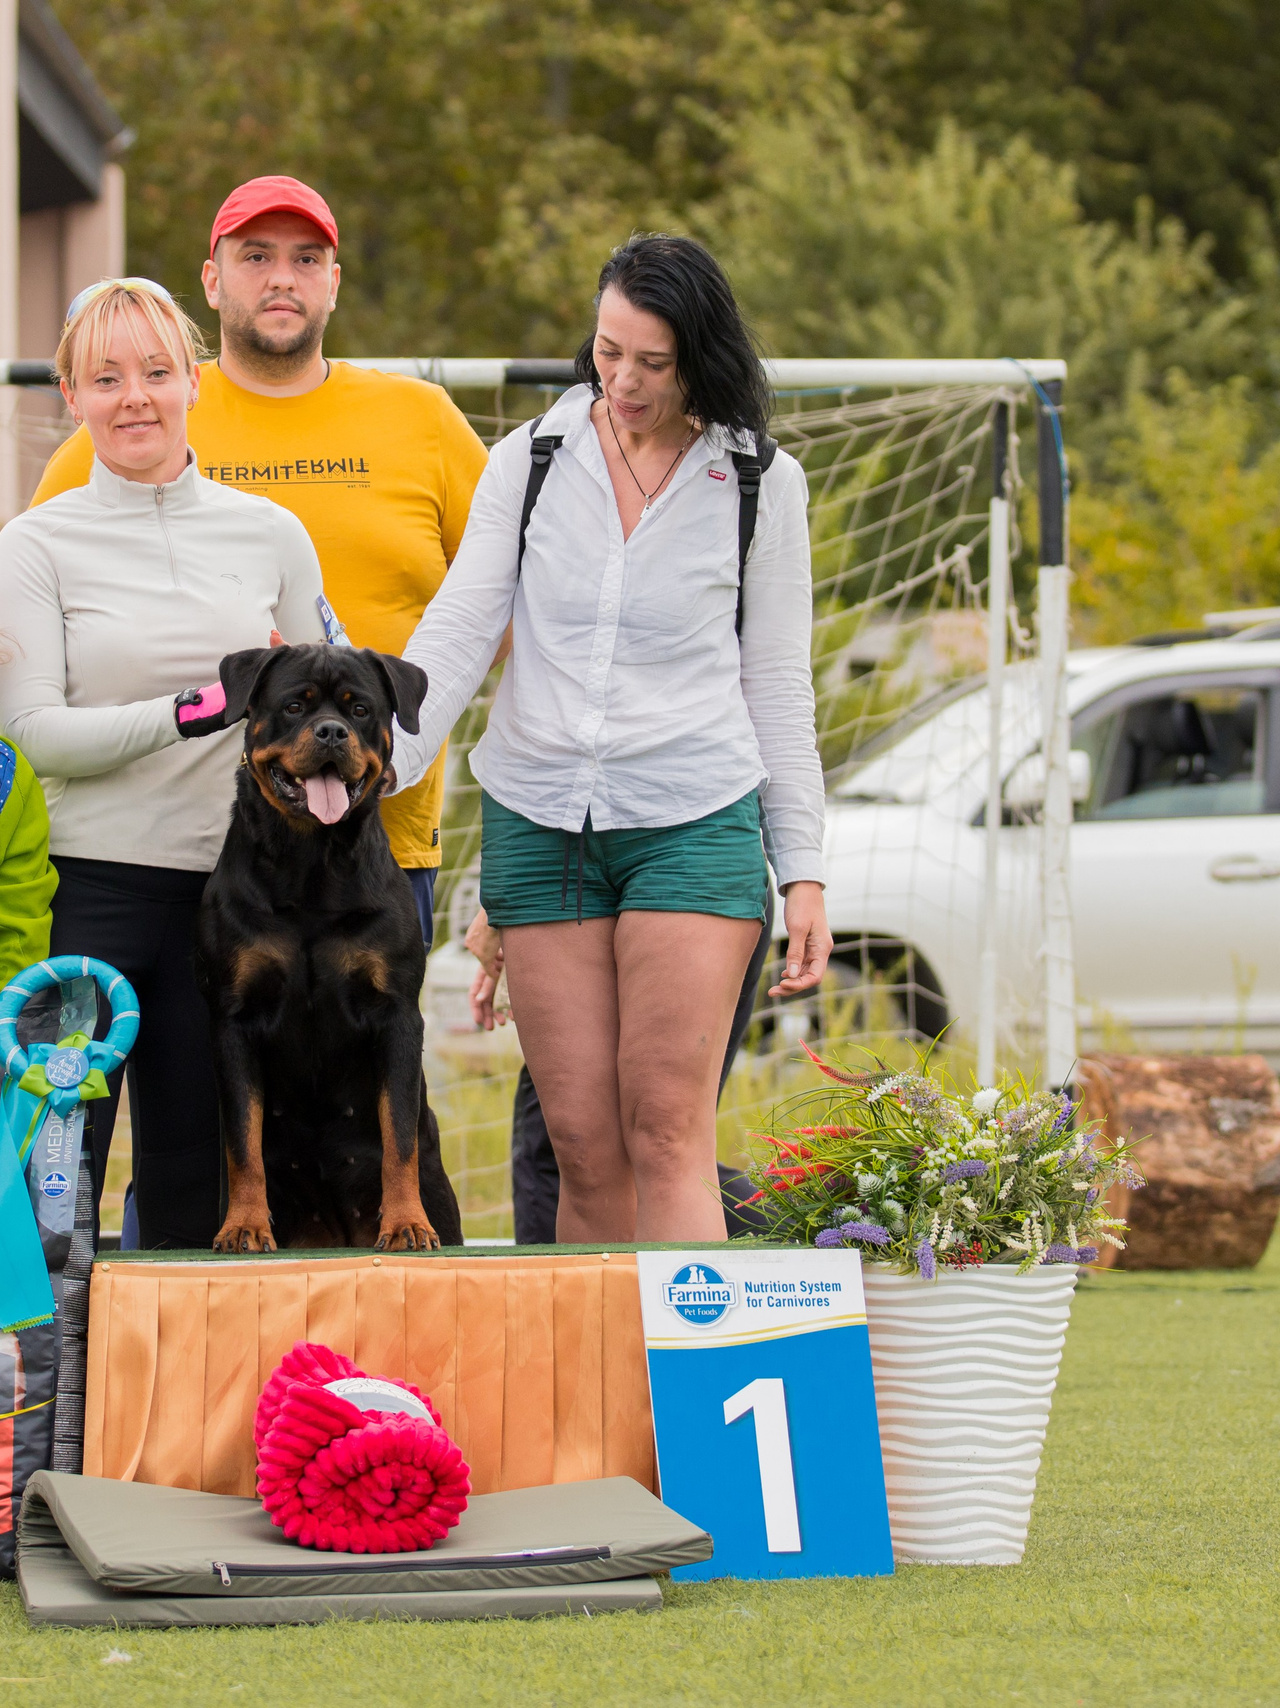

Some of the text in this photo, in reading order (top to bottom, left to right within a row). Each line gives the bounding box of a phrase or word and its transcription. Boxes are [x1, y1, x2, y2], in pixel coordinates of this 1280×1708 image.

[63, 1117, 77, 1164] UNIVERSAL
[42, 1181, 68, 1189] Farmina
[668, 1286, 731, 1302] Farmina
[744, 1280, 842, 1295] Nutrition System
[746, 1295, 830, 1308] for Carnivores
[684, 1308, 718, 1316] Pet Foods
[723, 1378, 802, 1553] 1
